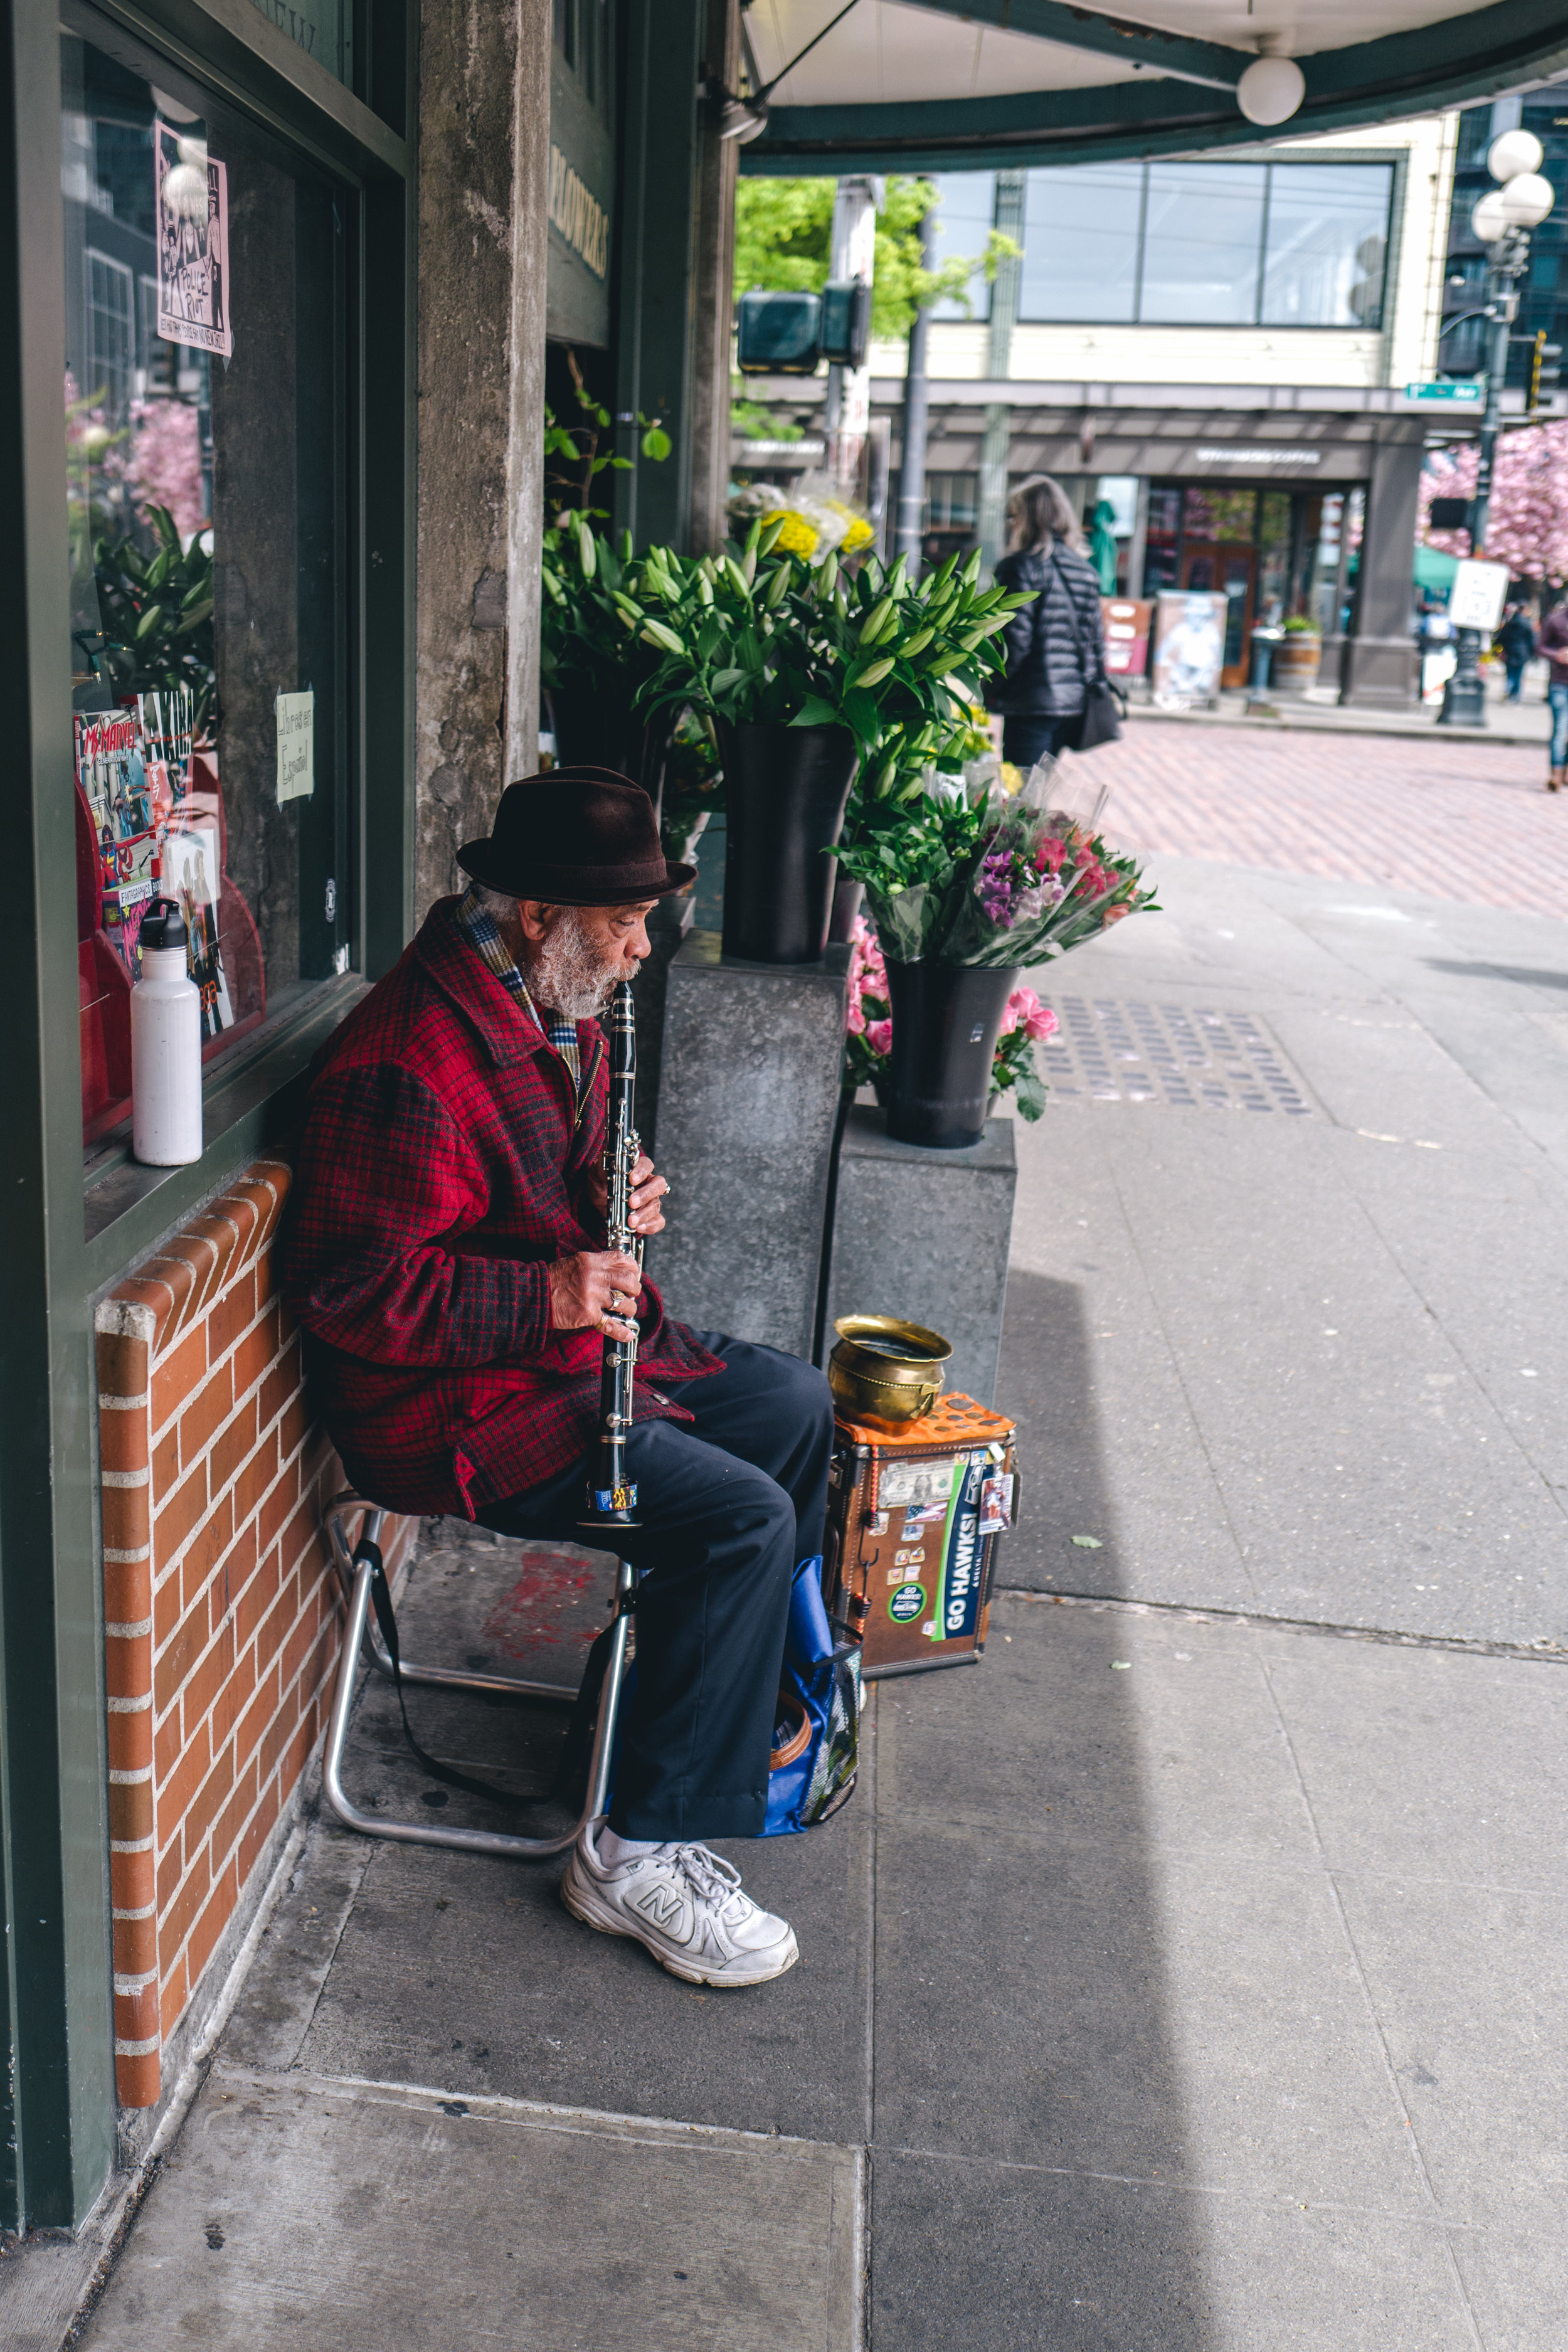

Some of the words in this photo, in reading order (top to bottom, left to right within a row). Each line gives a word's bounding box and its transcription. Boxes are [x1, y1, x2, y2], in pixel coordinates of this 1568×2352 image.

[181, 267, 209, 296] POLICE
[185, 292, 204, 320] RIOT
[278, 698, 302, 736] Libros
[304, 709, 312, 729] en
[101, 721, 136, 753] MARVEL
[282, 739, 307, 795] Español
[200, 980, 218, 1014] aga
[950, 1513, 977, 1597] HAWKS!
[904, 1586, 917, 1594] GO
[946, 1599, 967, 1631] GO
